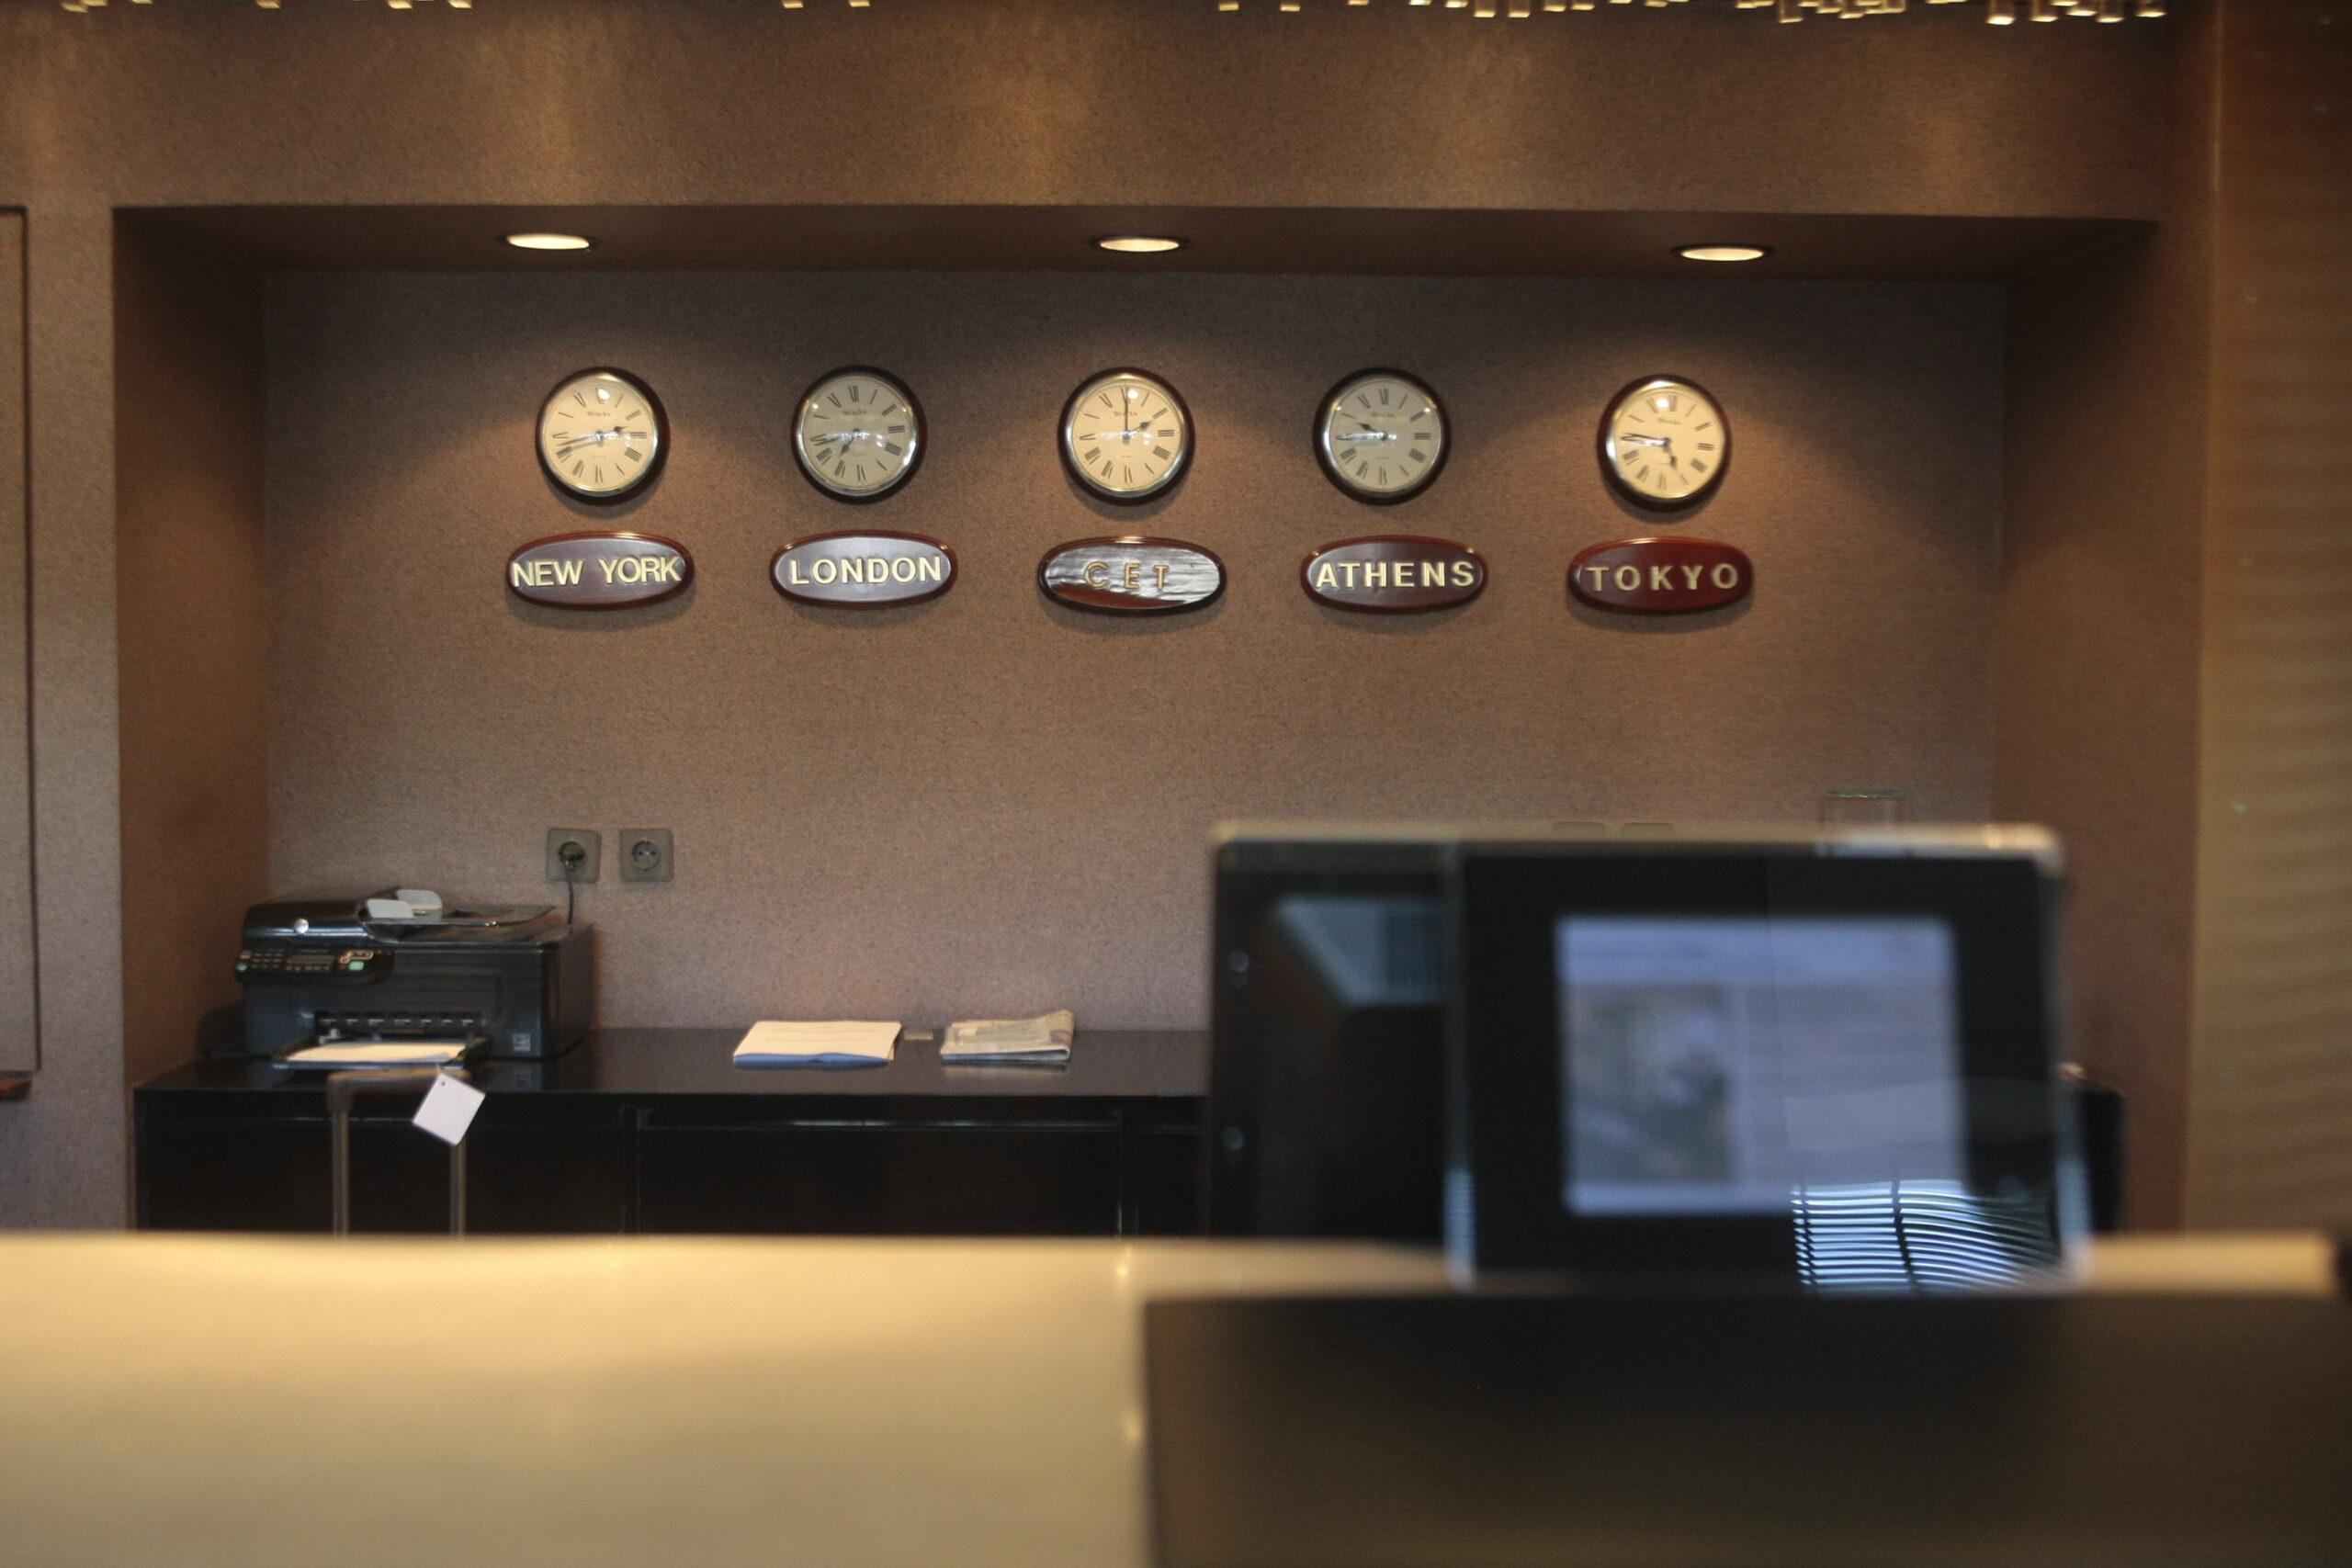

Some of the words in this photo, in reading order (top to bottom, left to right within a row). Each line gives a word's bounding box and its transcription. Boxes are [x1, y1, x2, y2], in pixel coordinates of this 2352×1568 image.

[511, 558, 584, 587] NEW
[598, 555, 683, 585] YORK
[789, 556, 943, 586] LONDON
[1083, 560, 1170, 591] CET
[1315, 559, 1476, 590] ATHENS
[1585, 562, 1739, 592] TOKYO
